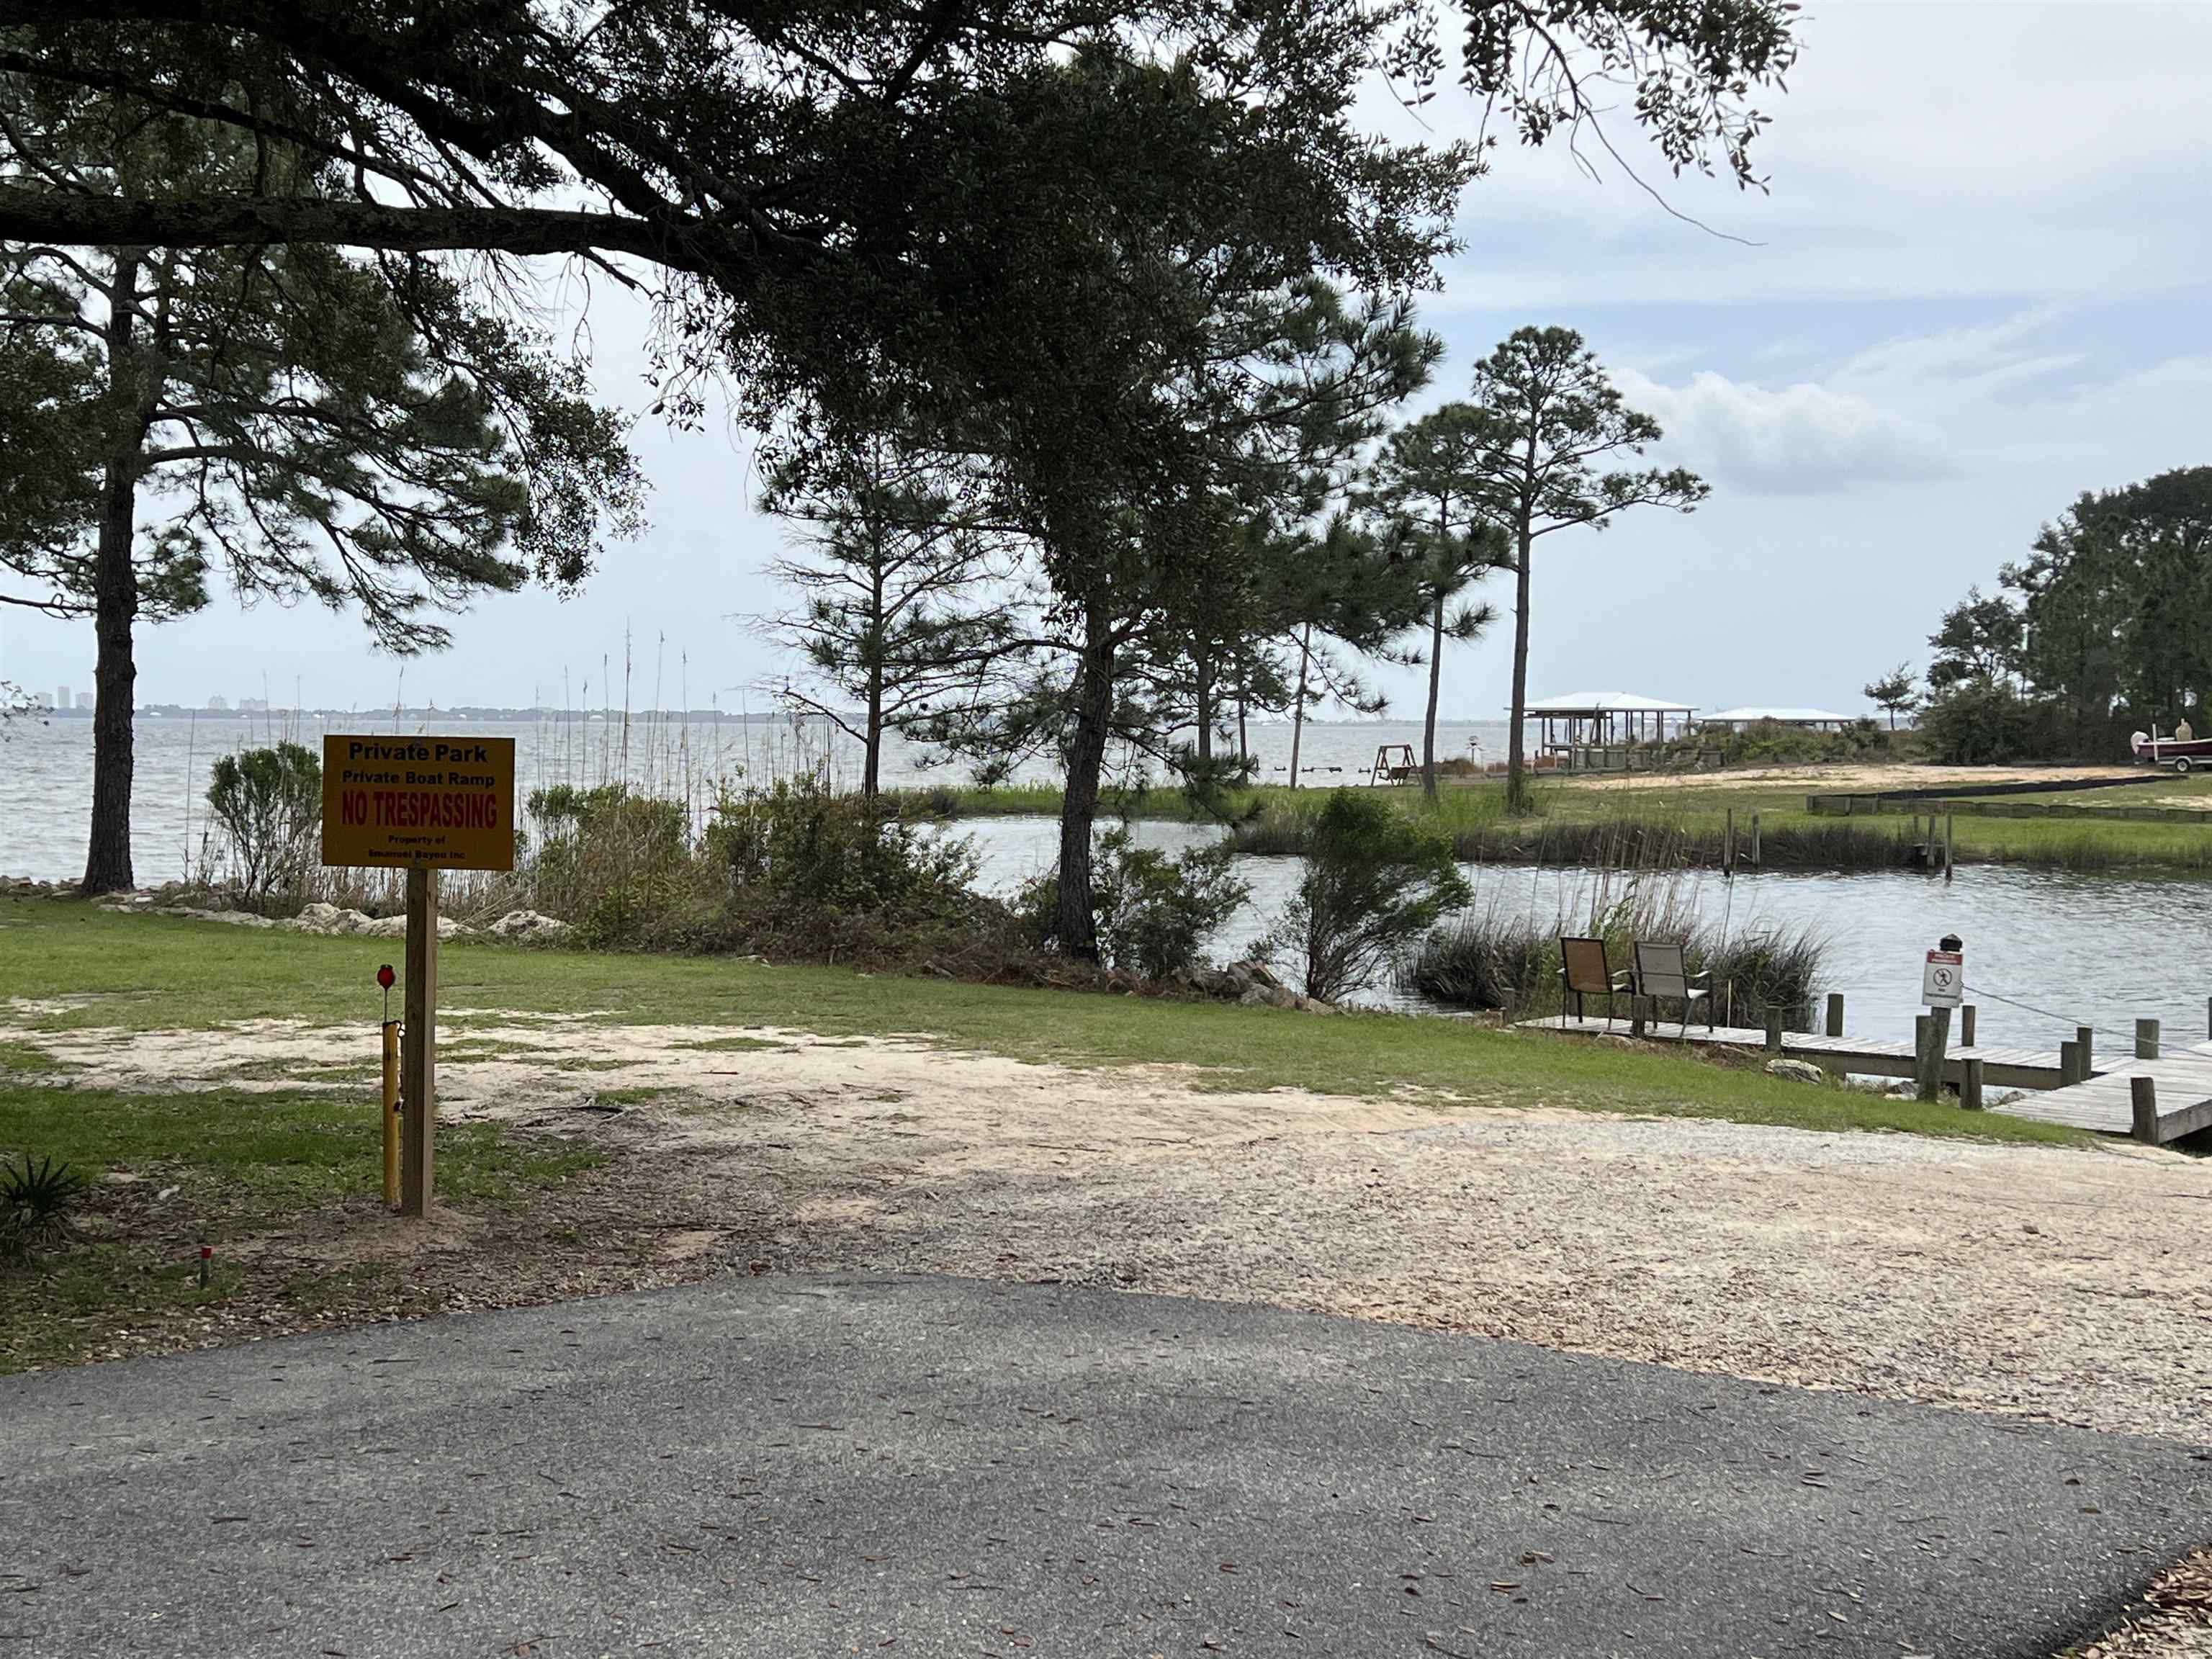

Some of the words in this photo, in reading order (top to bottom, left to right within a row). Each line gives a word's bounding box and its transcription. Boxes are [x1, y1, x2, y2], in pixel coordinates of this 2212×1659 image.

[349, 742, 430, 761] Private
[435, 744, 488, 763] Park
[342, 770, 400, 784] Private
[405, 772, 444, 786] Boat
[449, 773, 495, 788] Ramp
[342, 790, 367, 826] NO
[373, 791, 498, 829] TRESPASSING
[388, 835, 433, 845] Property
[436, 836, 446, 845] of
[369, 849, 412, 859] Emanuel
[415, 850, 447, 860] Bayou
